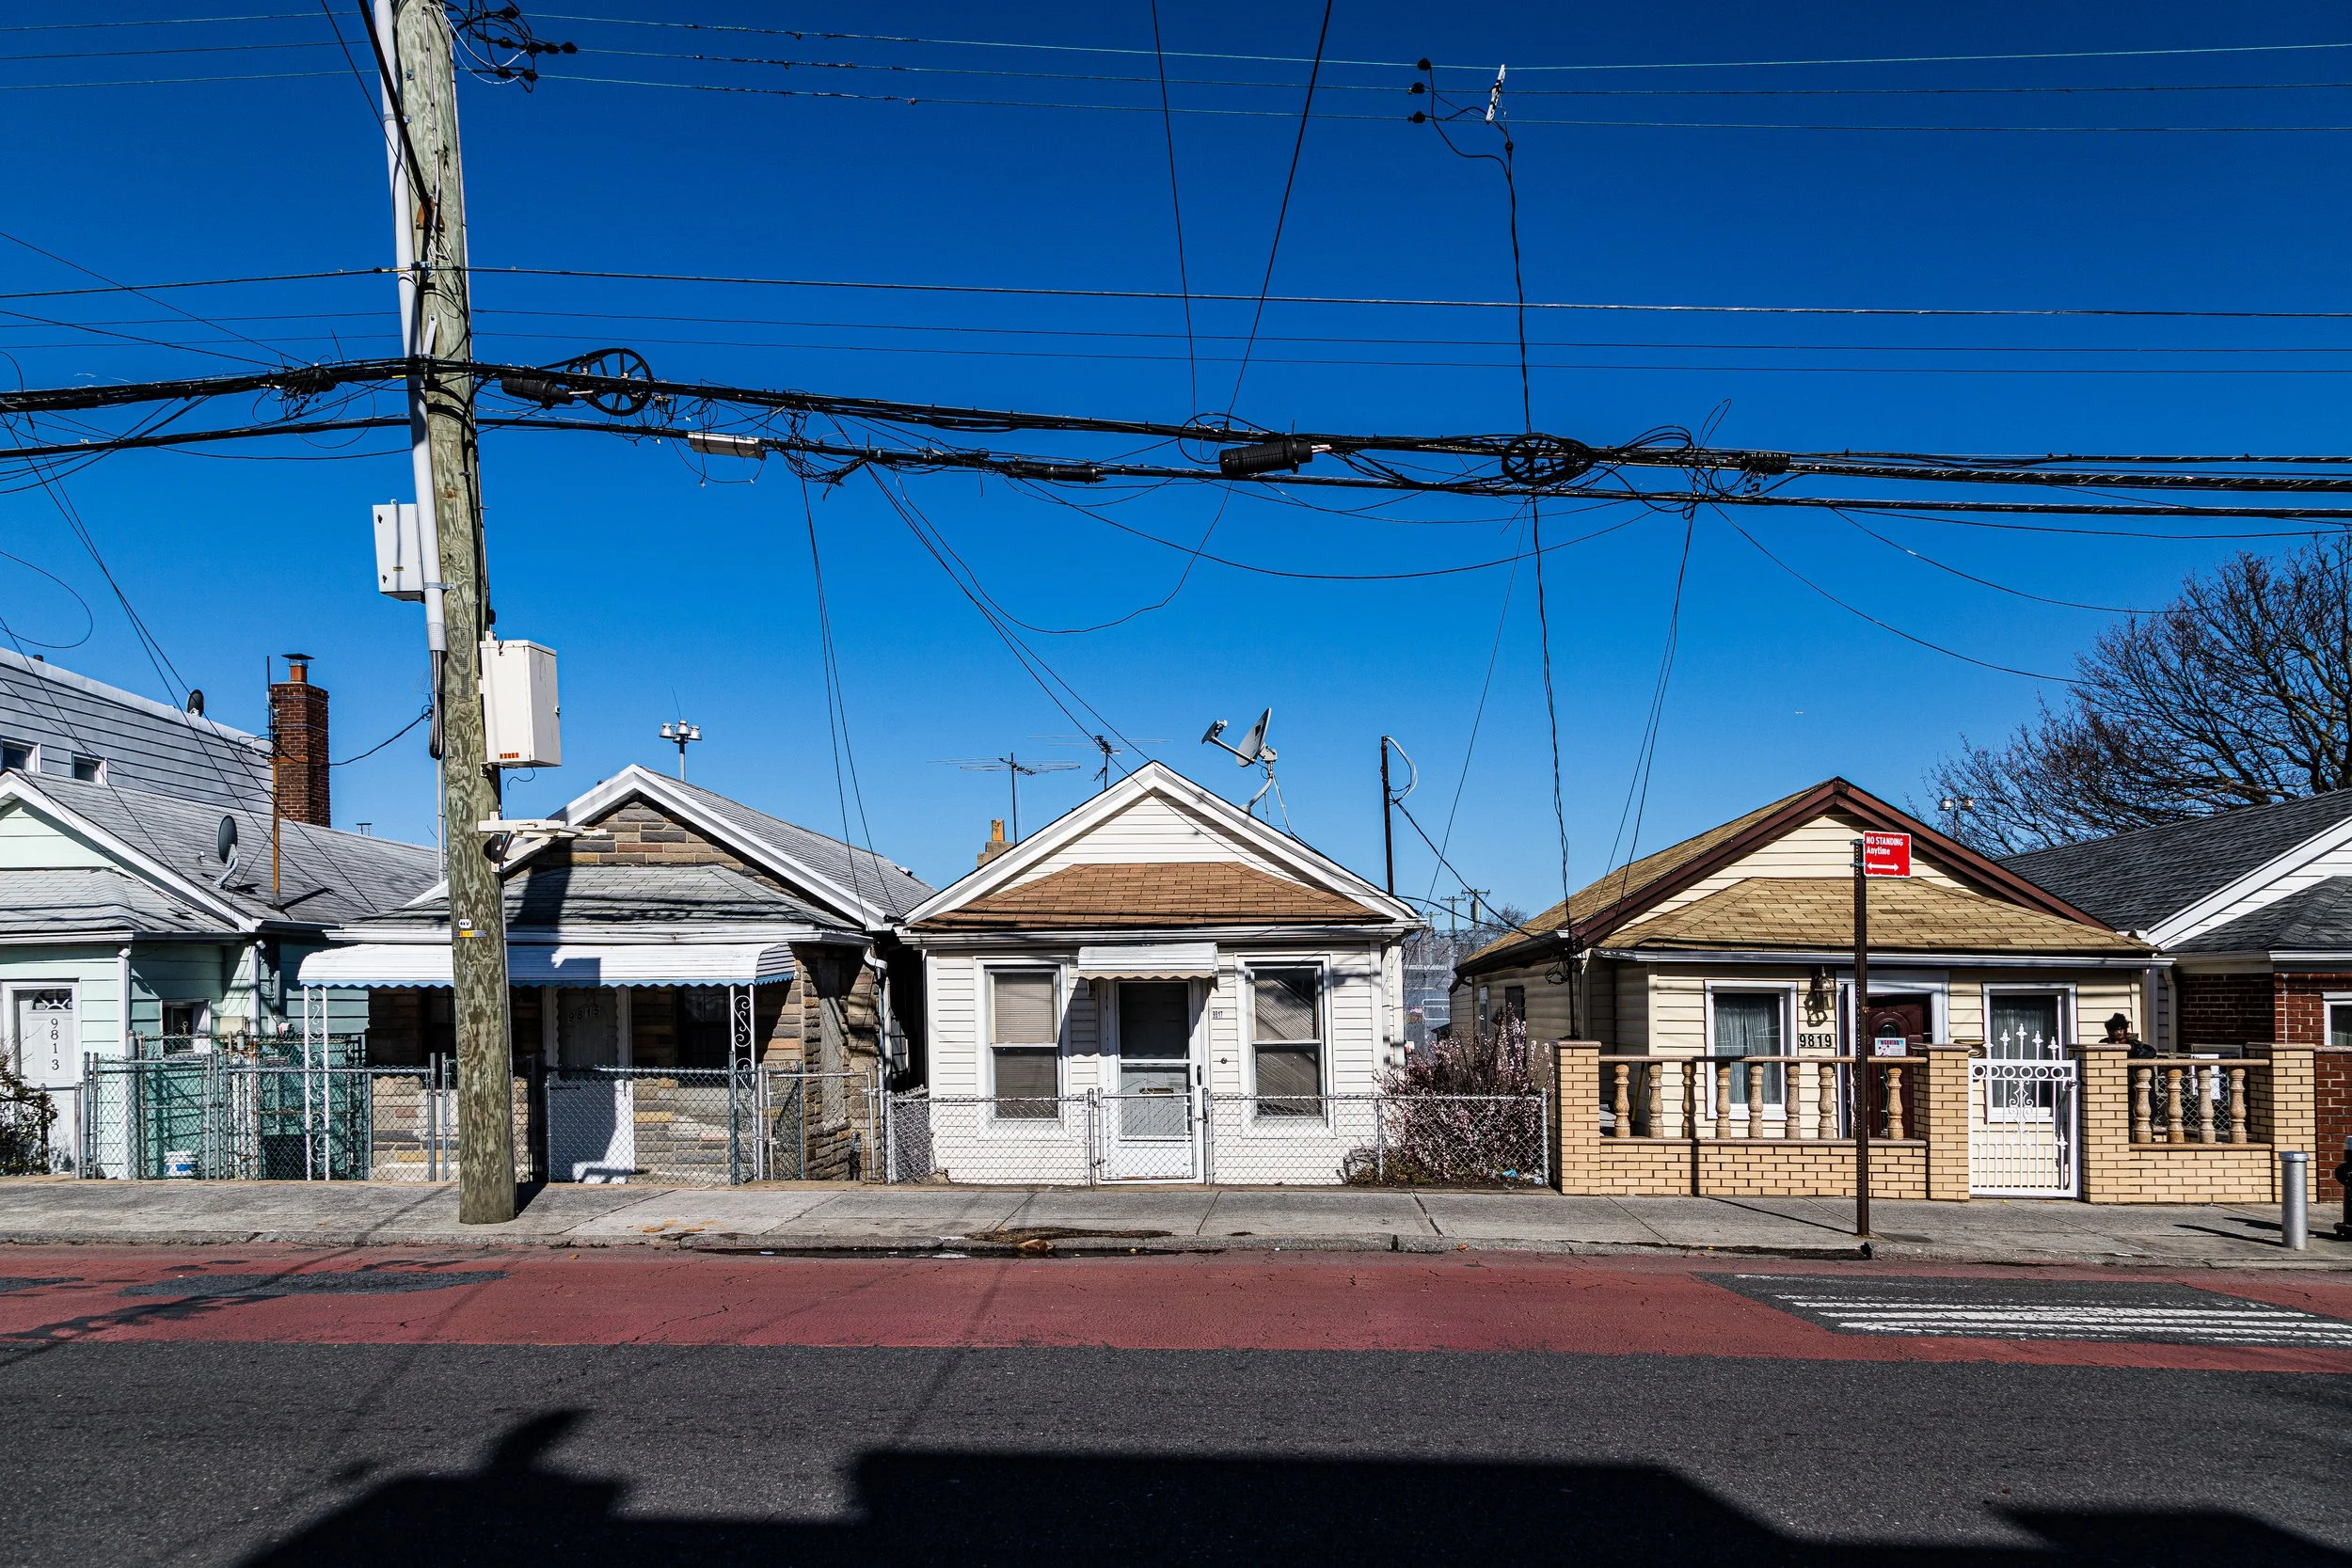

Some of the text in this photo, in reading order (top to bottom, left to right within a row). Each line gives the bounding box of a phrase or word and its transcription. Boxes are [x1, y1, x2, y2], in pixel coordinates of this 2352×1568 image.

[1866, 836, 1904, 847] NO STANDING
[1867, 847, 1891, 856] Anytime
[568, 1006, 600, 1023] 9815
[50, 1018, 59, 1070] 9813
[1799, 1034, 1832, 1047] 9819
